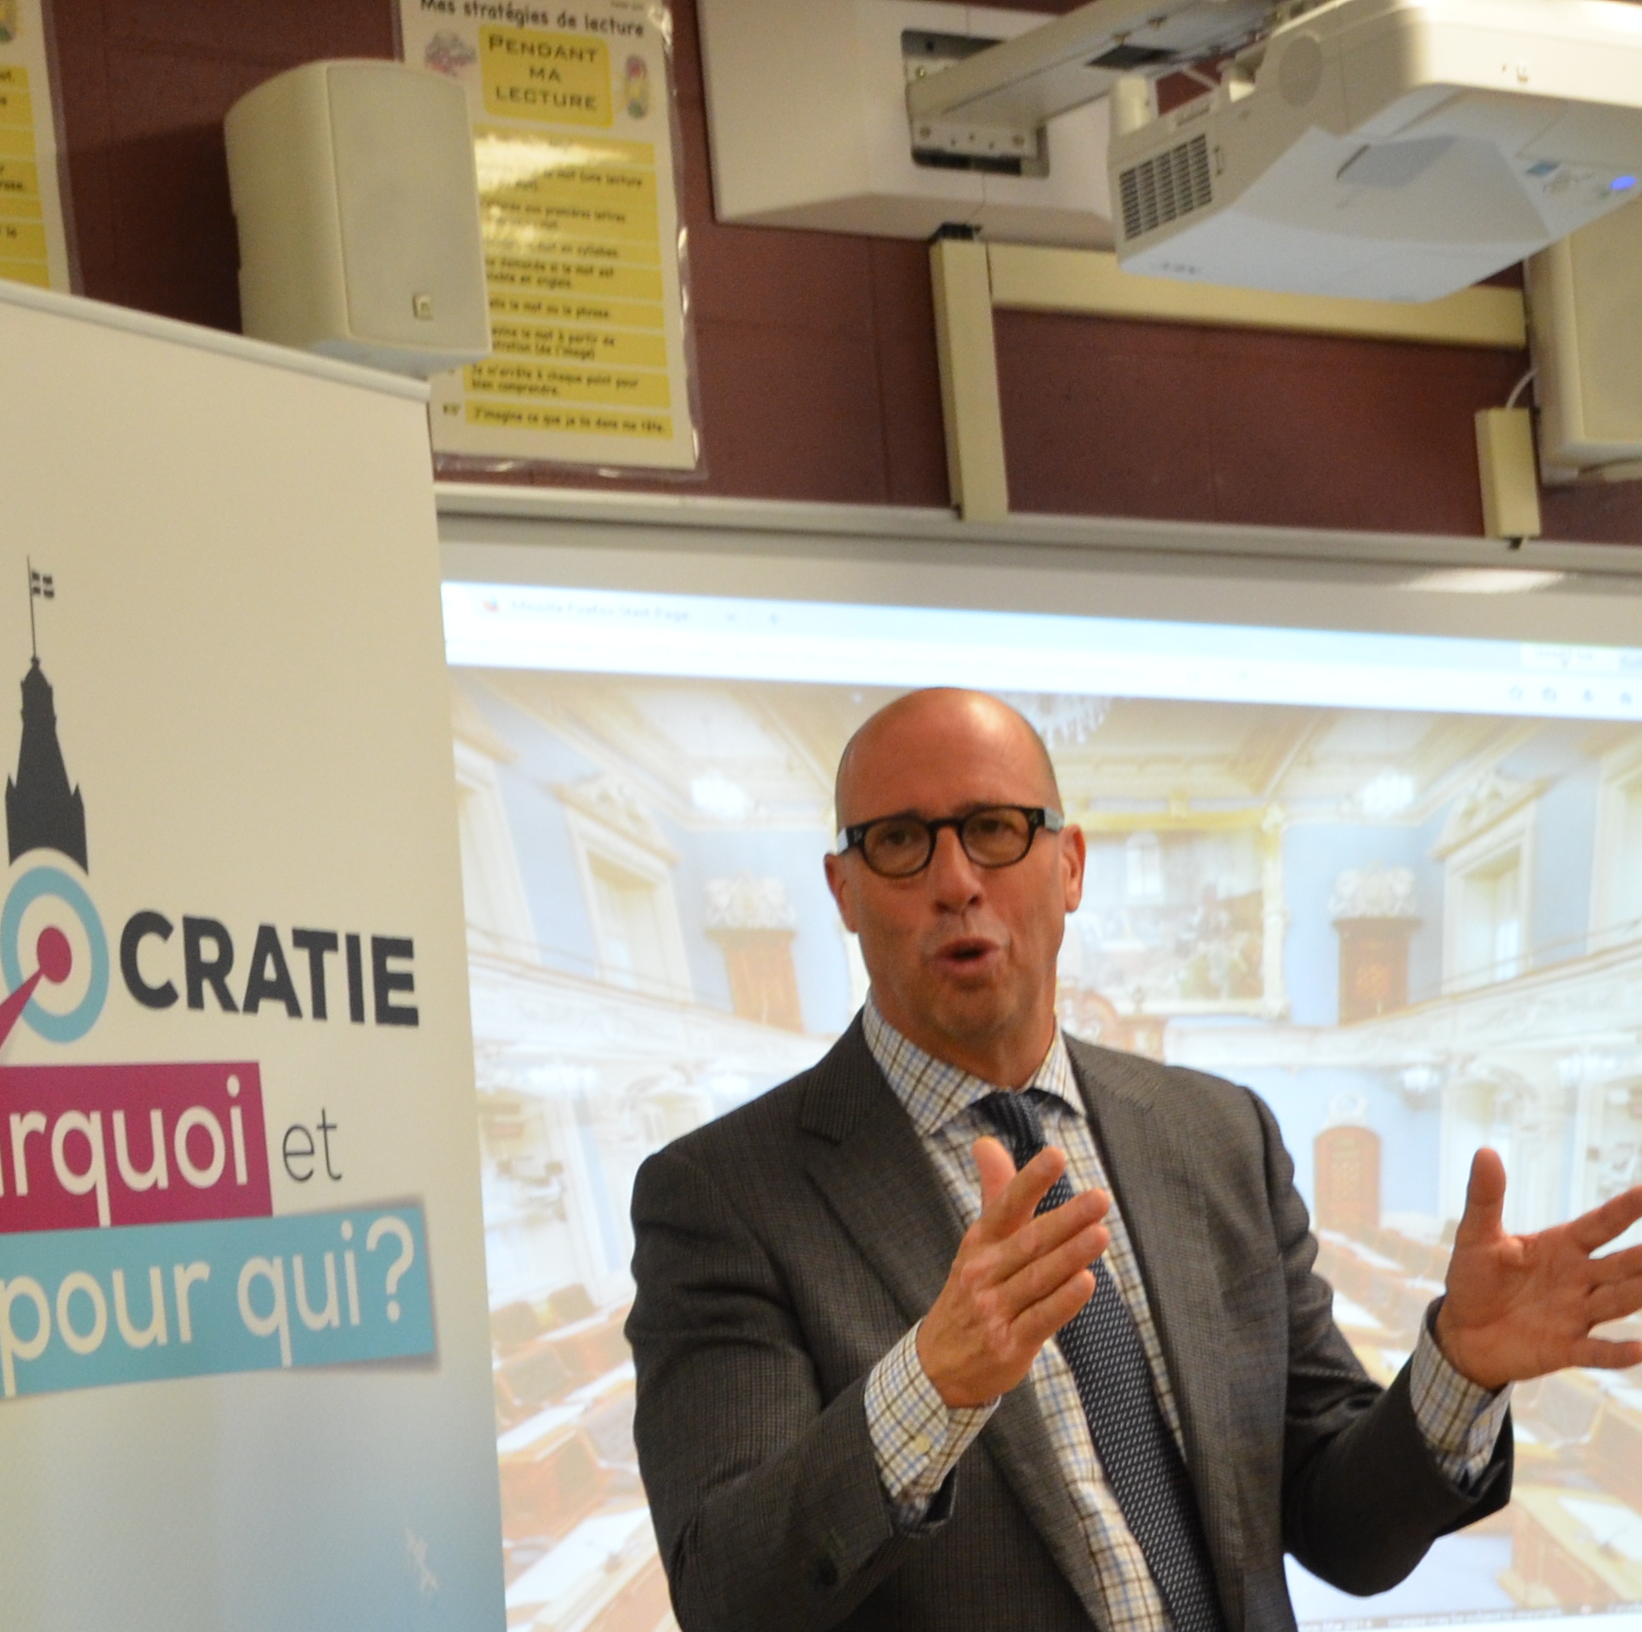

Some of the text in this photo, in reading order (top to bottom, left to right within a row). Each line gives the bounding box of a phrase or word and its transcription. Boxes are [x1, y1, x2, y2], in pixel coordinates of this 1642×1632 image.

[463, 1, 549, 28] stratégies
[557, 11, 577, 28] de
[585, 17, 644, 38] lecture
[488, 34, 598, 63] PENDANT
[529, 66, 562, 82] MA
[496, 86, 597, 111] LECTURE
[283, 1108, 343, 1184] et
[236, 1217, 414, 1367] qui?
